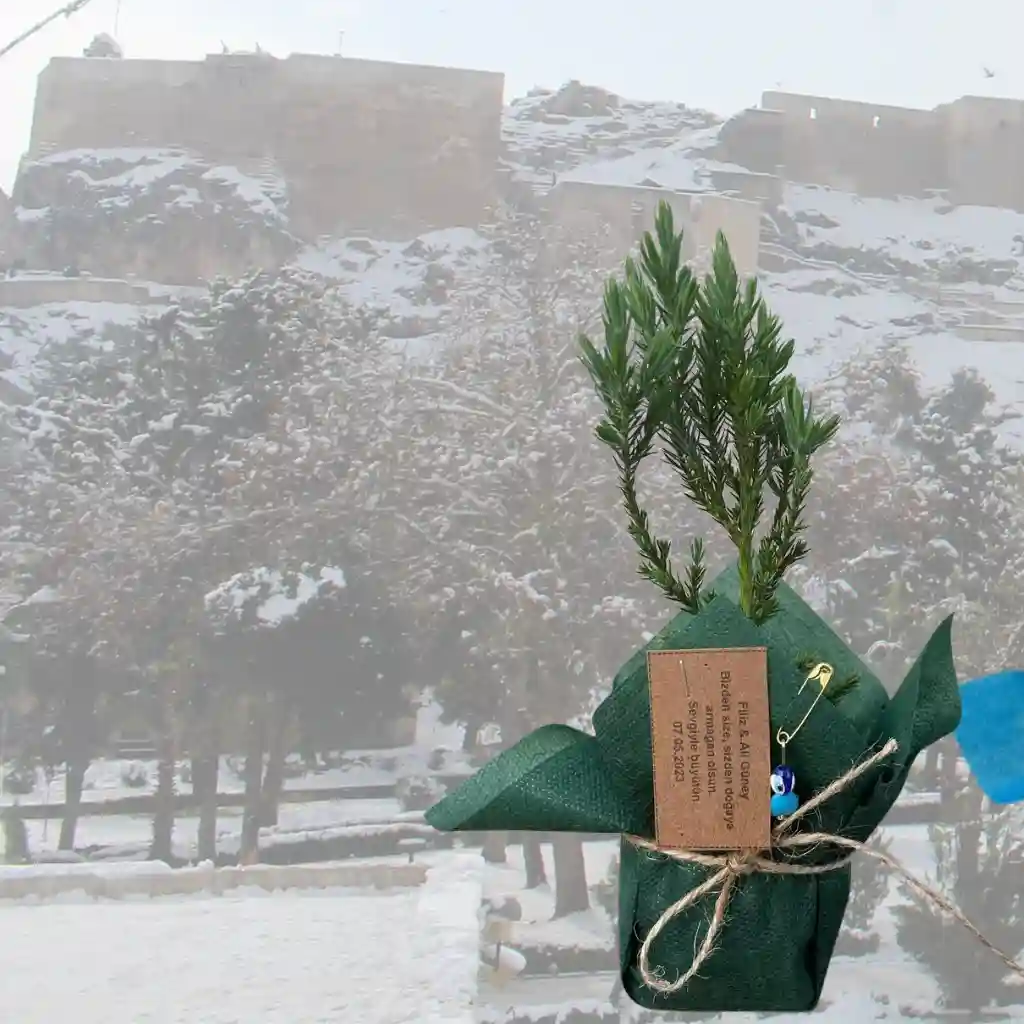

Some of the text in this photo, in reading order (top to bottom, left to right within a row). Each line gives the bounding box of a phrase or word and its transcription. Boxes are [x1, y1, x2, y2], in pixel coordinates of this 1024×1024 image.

[720, 671, 732, 712] Bizden
[687, 700, 700, 752] Sevgiyle
[738, 701, 749, 726] Filiz
[739, 730, 749, 738] &
[739, 742, 750, 758] Ali
[723, 745, 734, 784] sizden
